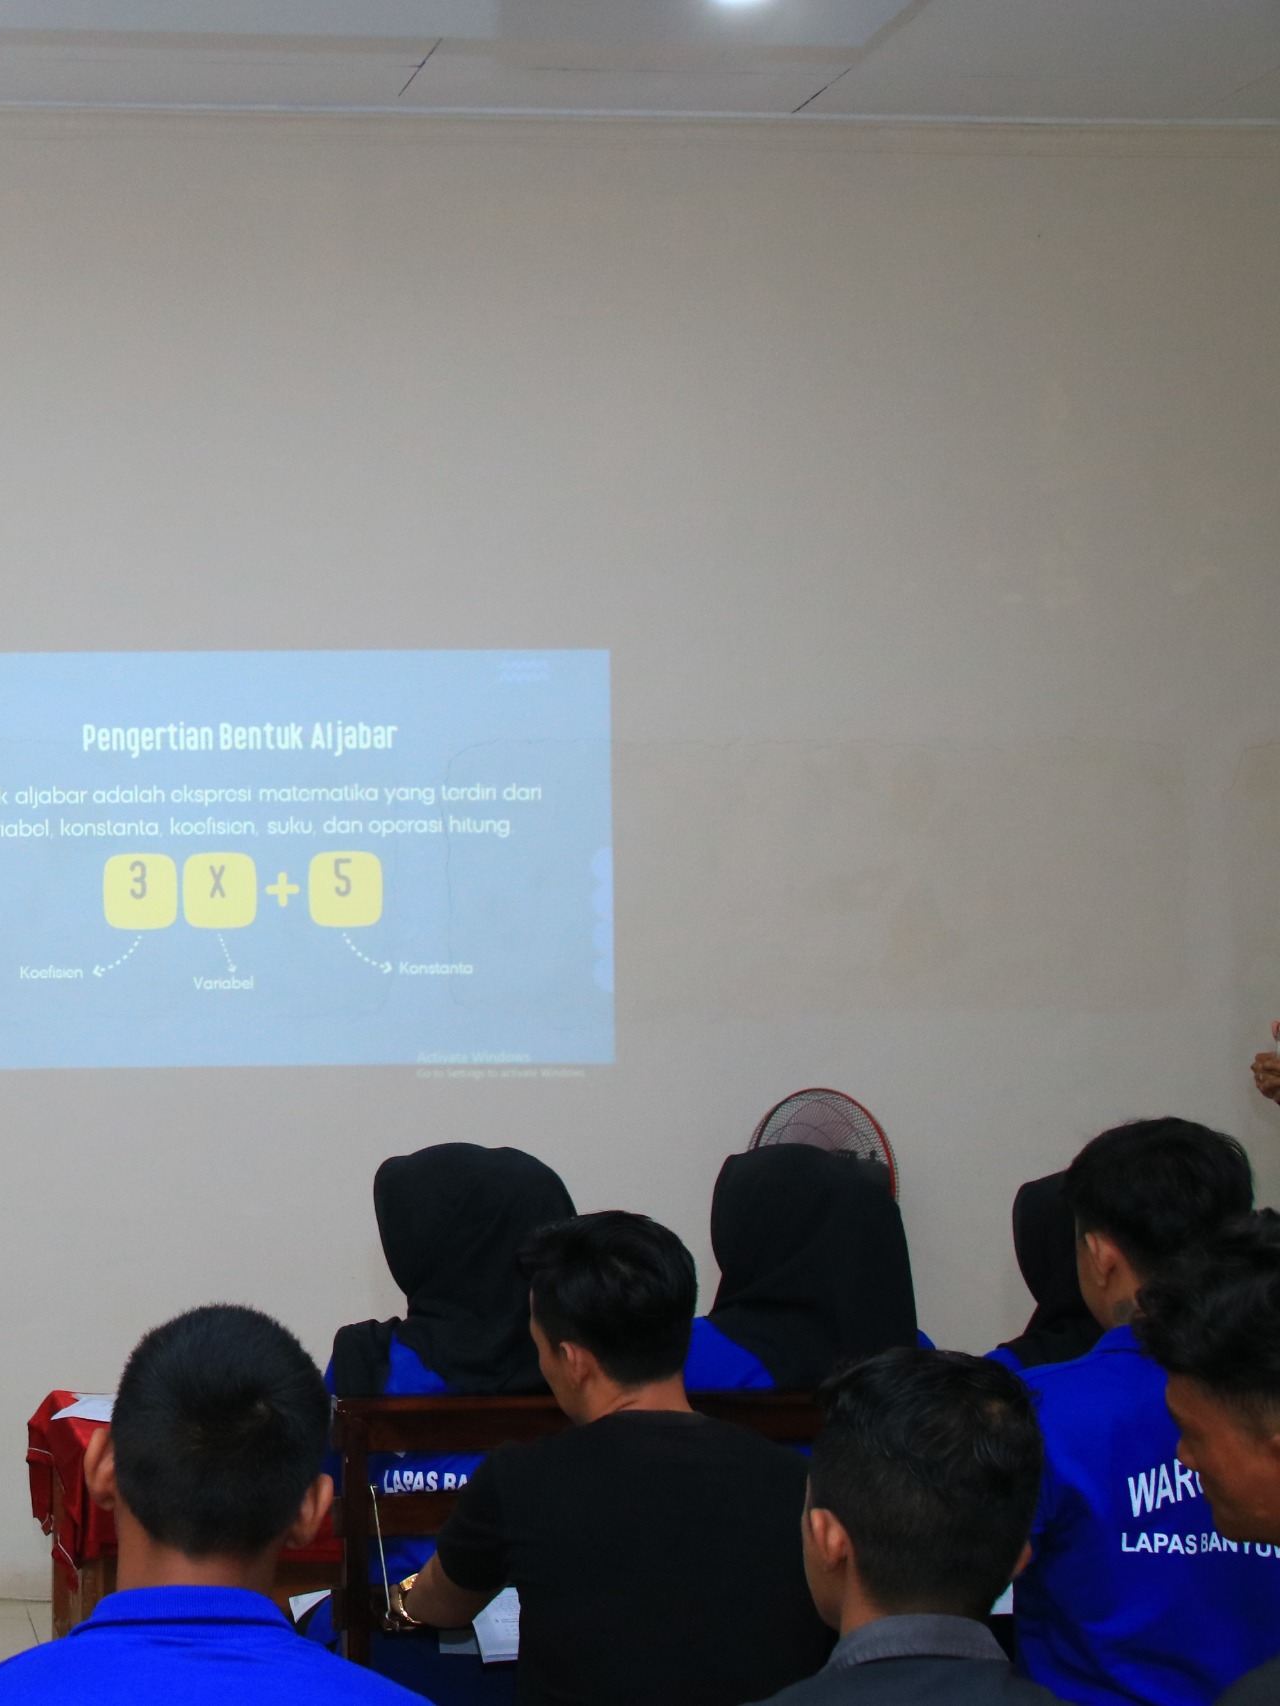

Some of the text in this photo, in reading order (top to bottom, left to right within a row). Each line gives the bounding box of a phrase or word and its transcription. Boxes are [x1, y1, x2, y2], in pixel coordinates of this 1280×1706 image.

[82, 720, 398, 758] Pengertian Bentuk Aljabar
[15, 786, 87, 808] aljabar
[93, 784, 165, 804] adalah
[171, 784, 252, 807] ekspresi
[259, 783, 379, 803] matematika
[384, 785, 435, 805] yang
[441, 783, 497, 802] terdiri
[503, 782, 543, 801] dari
[60, 818, 163, 838] konstanta,
[170, 816, 259, 837] koefisien,
[268, 815, 316, 836] suku,
[323, 815, 363, 834] dan
[369, 816, 443, 837] operasi
[129, 860, 148, 899] 3
[333, 858, 353, 898] 5
[20, 966, 84, 980] Koefisien
[399, 961, 474, 976] Konstanta
[193, 975, 255, 990] Variabel
[383, 1469, 439, 1494] LAPAS
[1121, 1532, 1198, 1555] LAPAS
